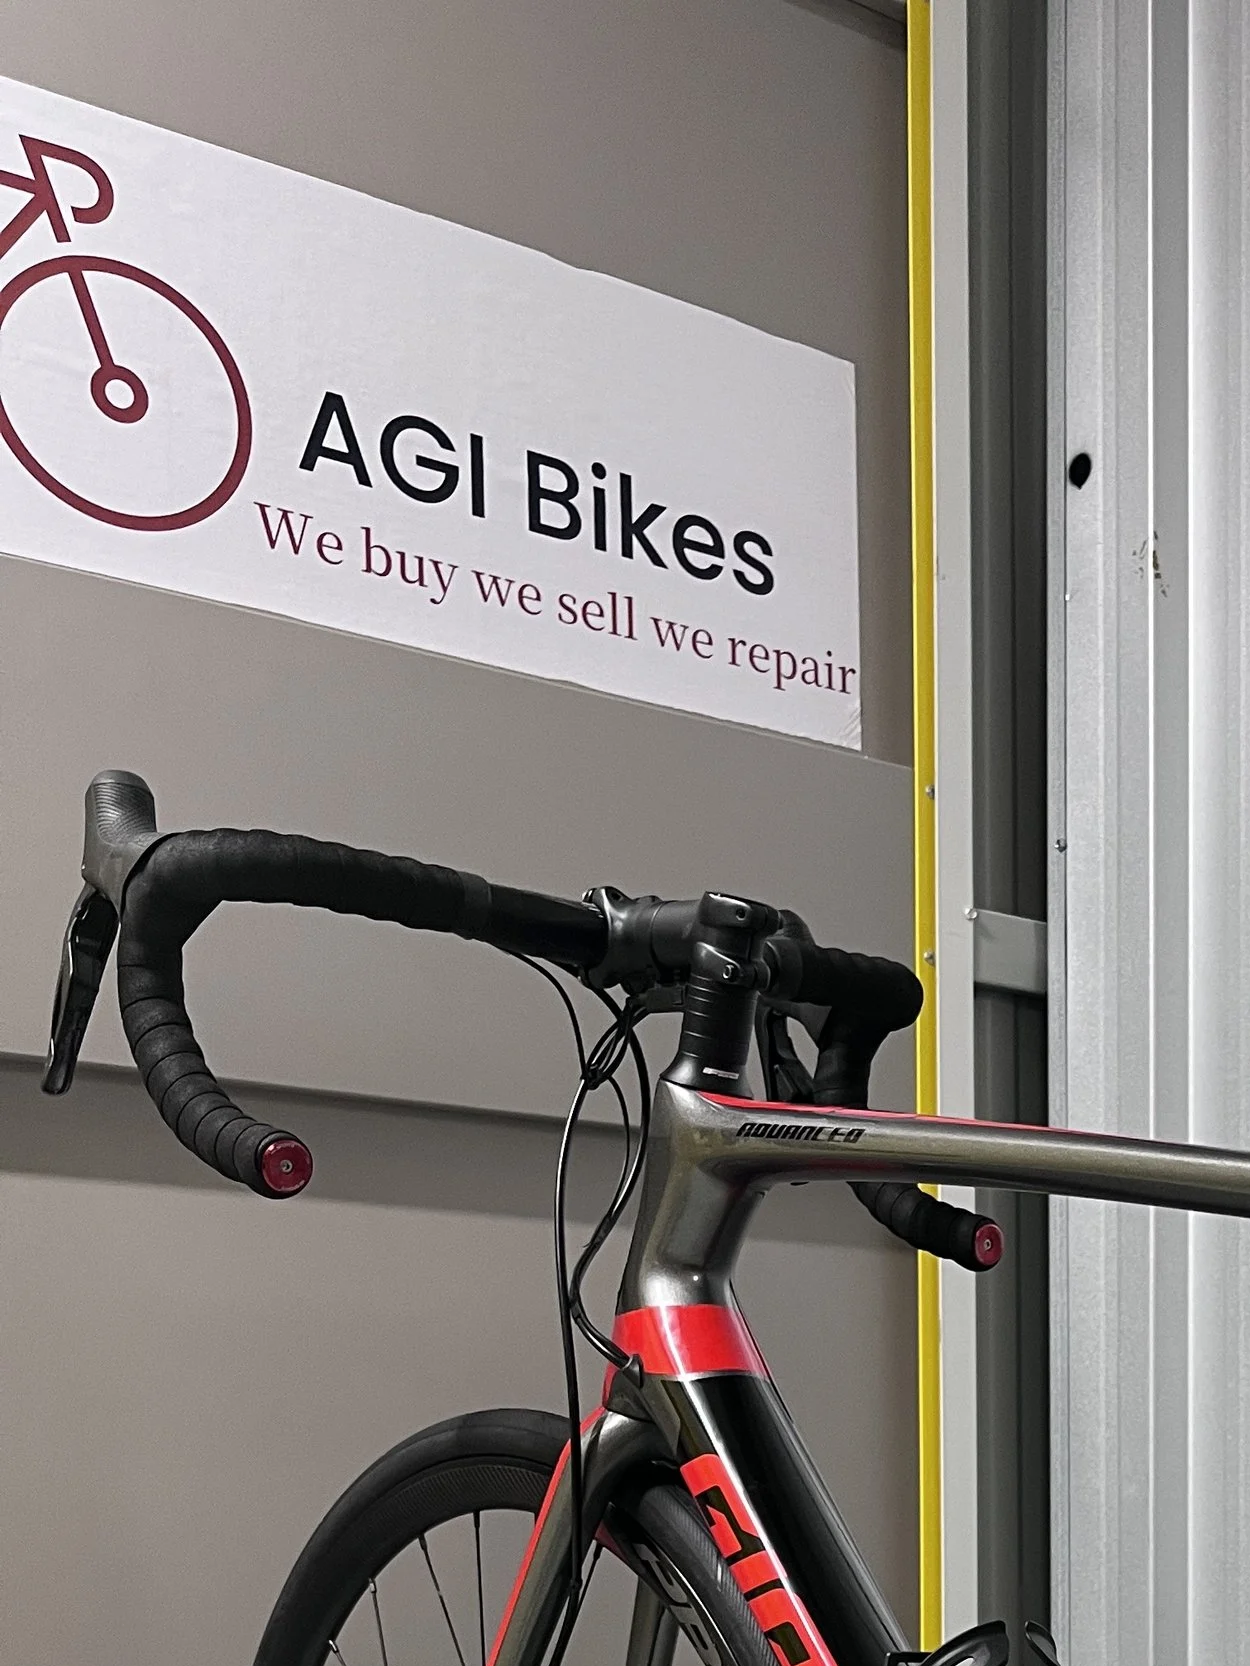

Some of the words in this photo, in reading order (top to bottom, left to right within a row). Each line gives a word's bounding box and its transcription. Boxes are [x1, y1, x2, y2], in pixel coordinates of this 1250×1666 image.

[299, 391, 485, 518] AGI
[527, 450, 774, 595] Bikes
[254, 502, 344, 565] We
[361, 526, 458, 605] buy
[471, 570, 542, 615] we
[557, 592, 638, 640] sell
[650, 617, 713, 659] we
[728, 637, 856, 694] repair
[736, 1122, 866, 1143] ADVANCED
